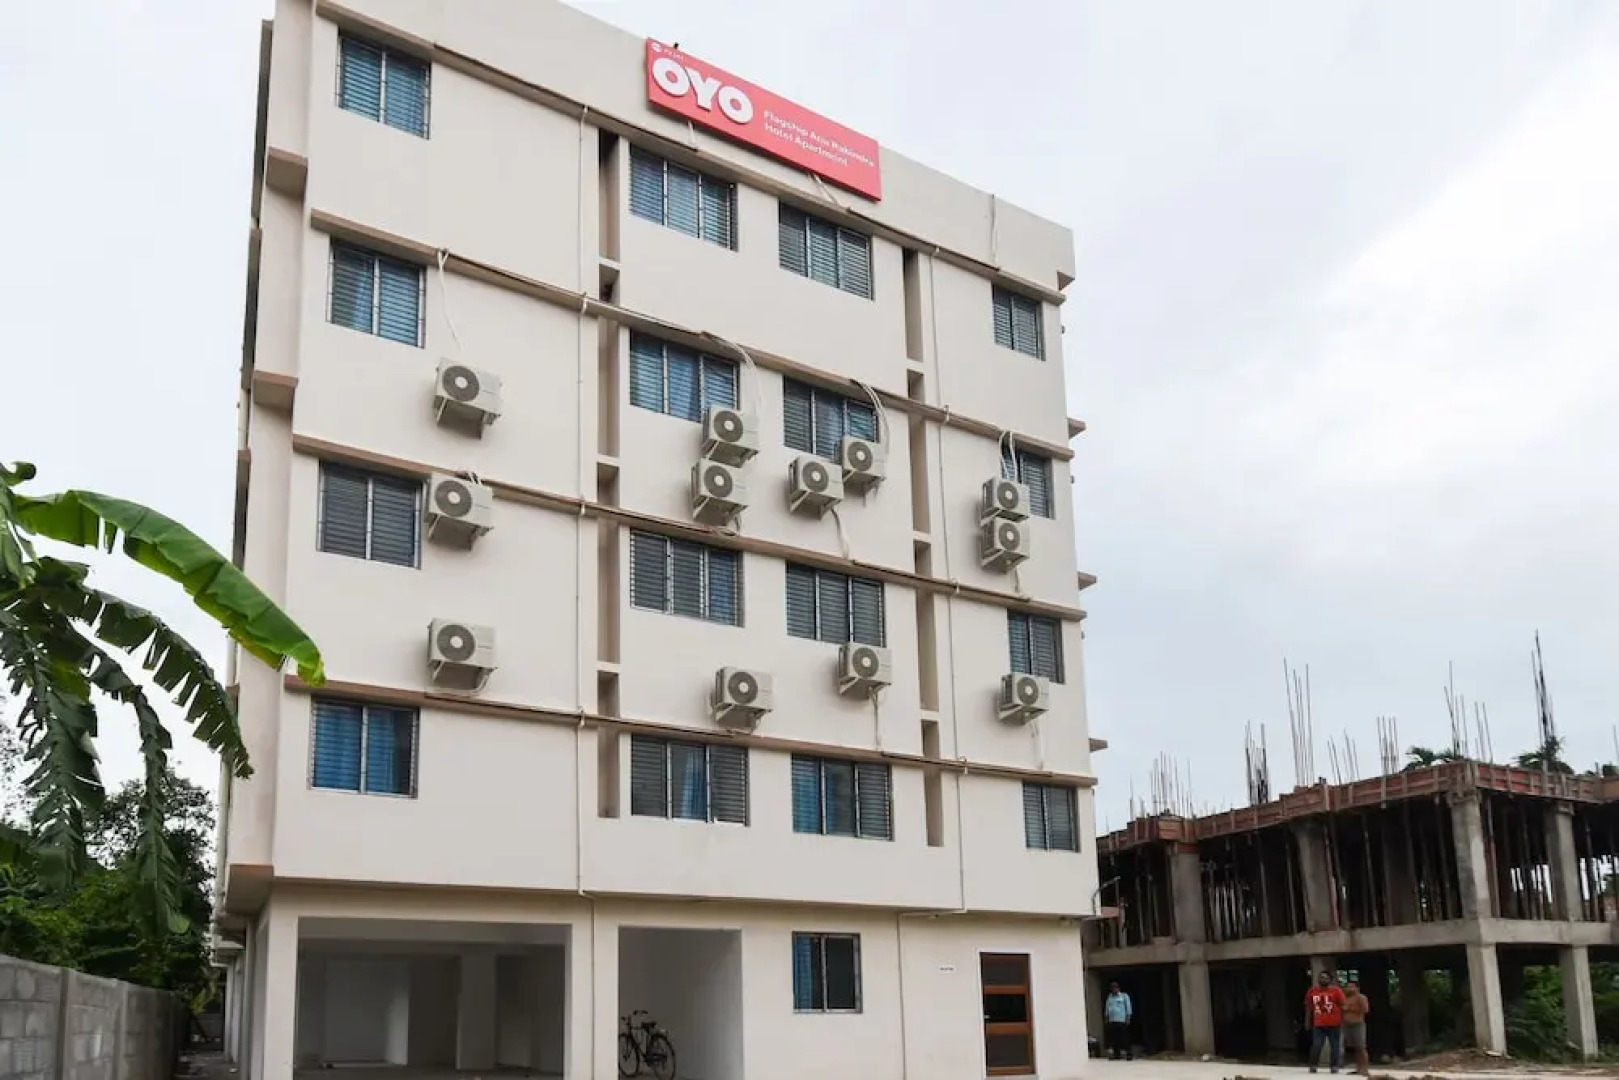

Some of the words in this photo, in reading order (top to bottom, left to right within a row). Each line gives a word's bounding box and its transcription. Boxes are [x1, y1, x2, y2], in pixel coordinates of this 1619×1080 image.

[652, 57, 754, 124] OYO
[763, 109, 808, 137] Flagship
[764, 122, 792, 141] Hotel
[795, 137, 848, 166] Apartment
